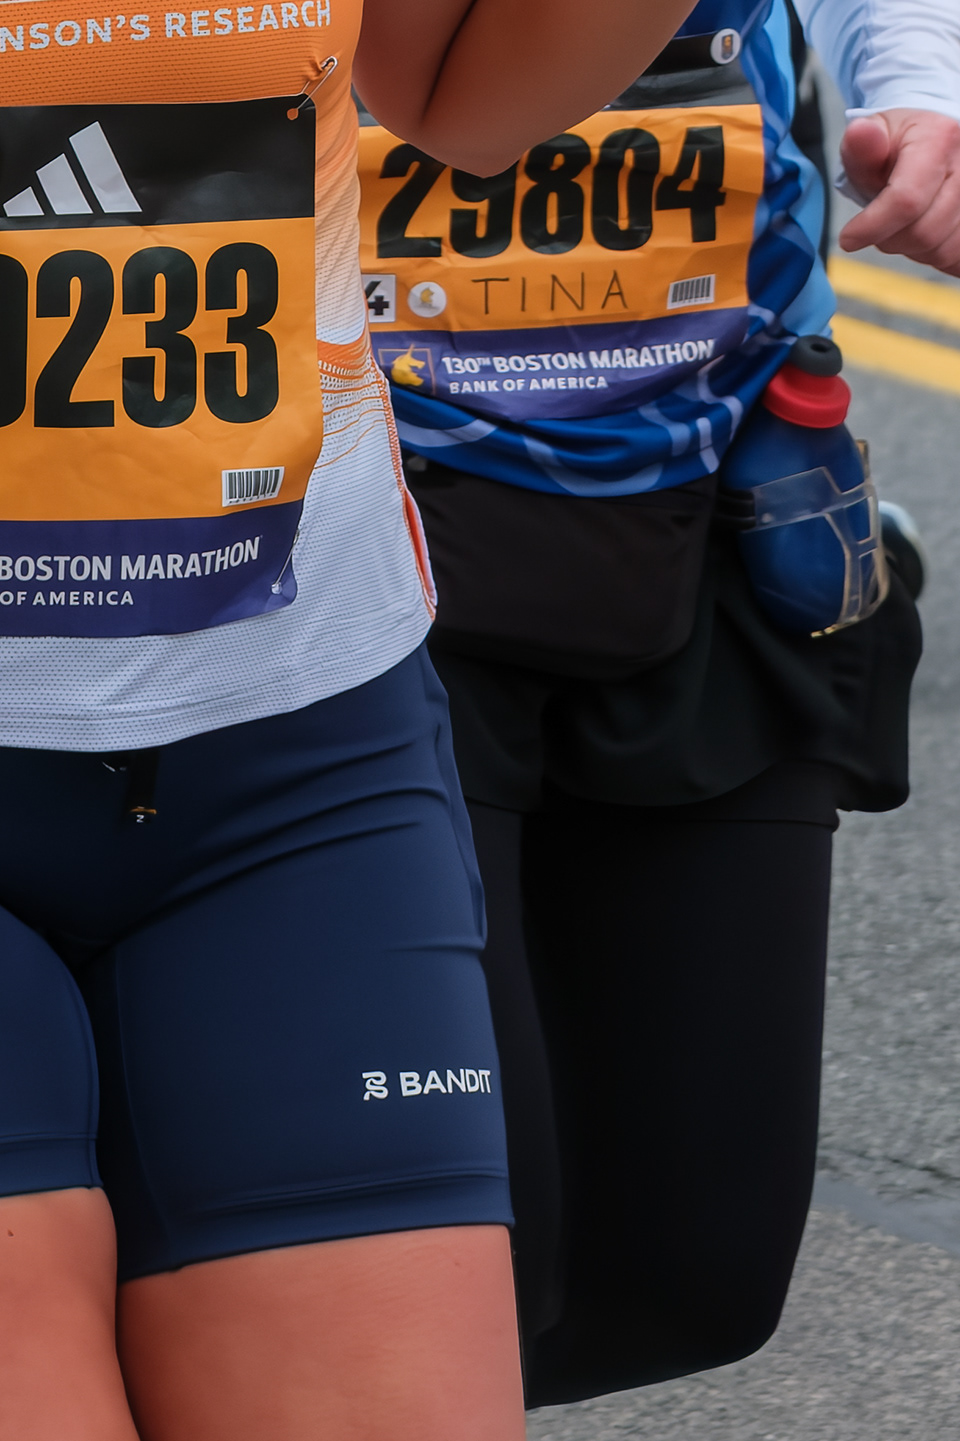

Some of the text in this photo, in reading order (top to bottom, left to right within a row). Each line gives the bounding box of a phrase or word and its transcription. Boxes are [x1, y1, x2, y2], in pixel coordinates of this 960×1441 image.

[376, 125, 726, 258] 29804
[471, 270, 628, 315] TINA
[442, 338, 716, 375] 130TH BOSTON MARATHON
[449, 375, 609, 395] BANK OF AMERICA
[121, 535, 261, 581] MARATHON
[33, 590, 135, 606] AMERICA
[399, 1068, 491, 1097] BANDIT
